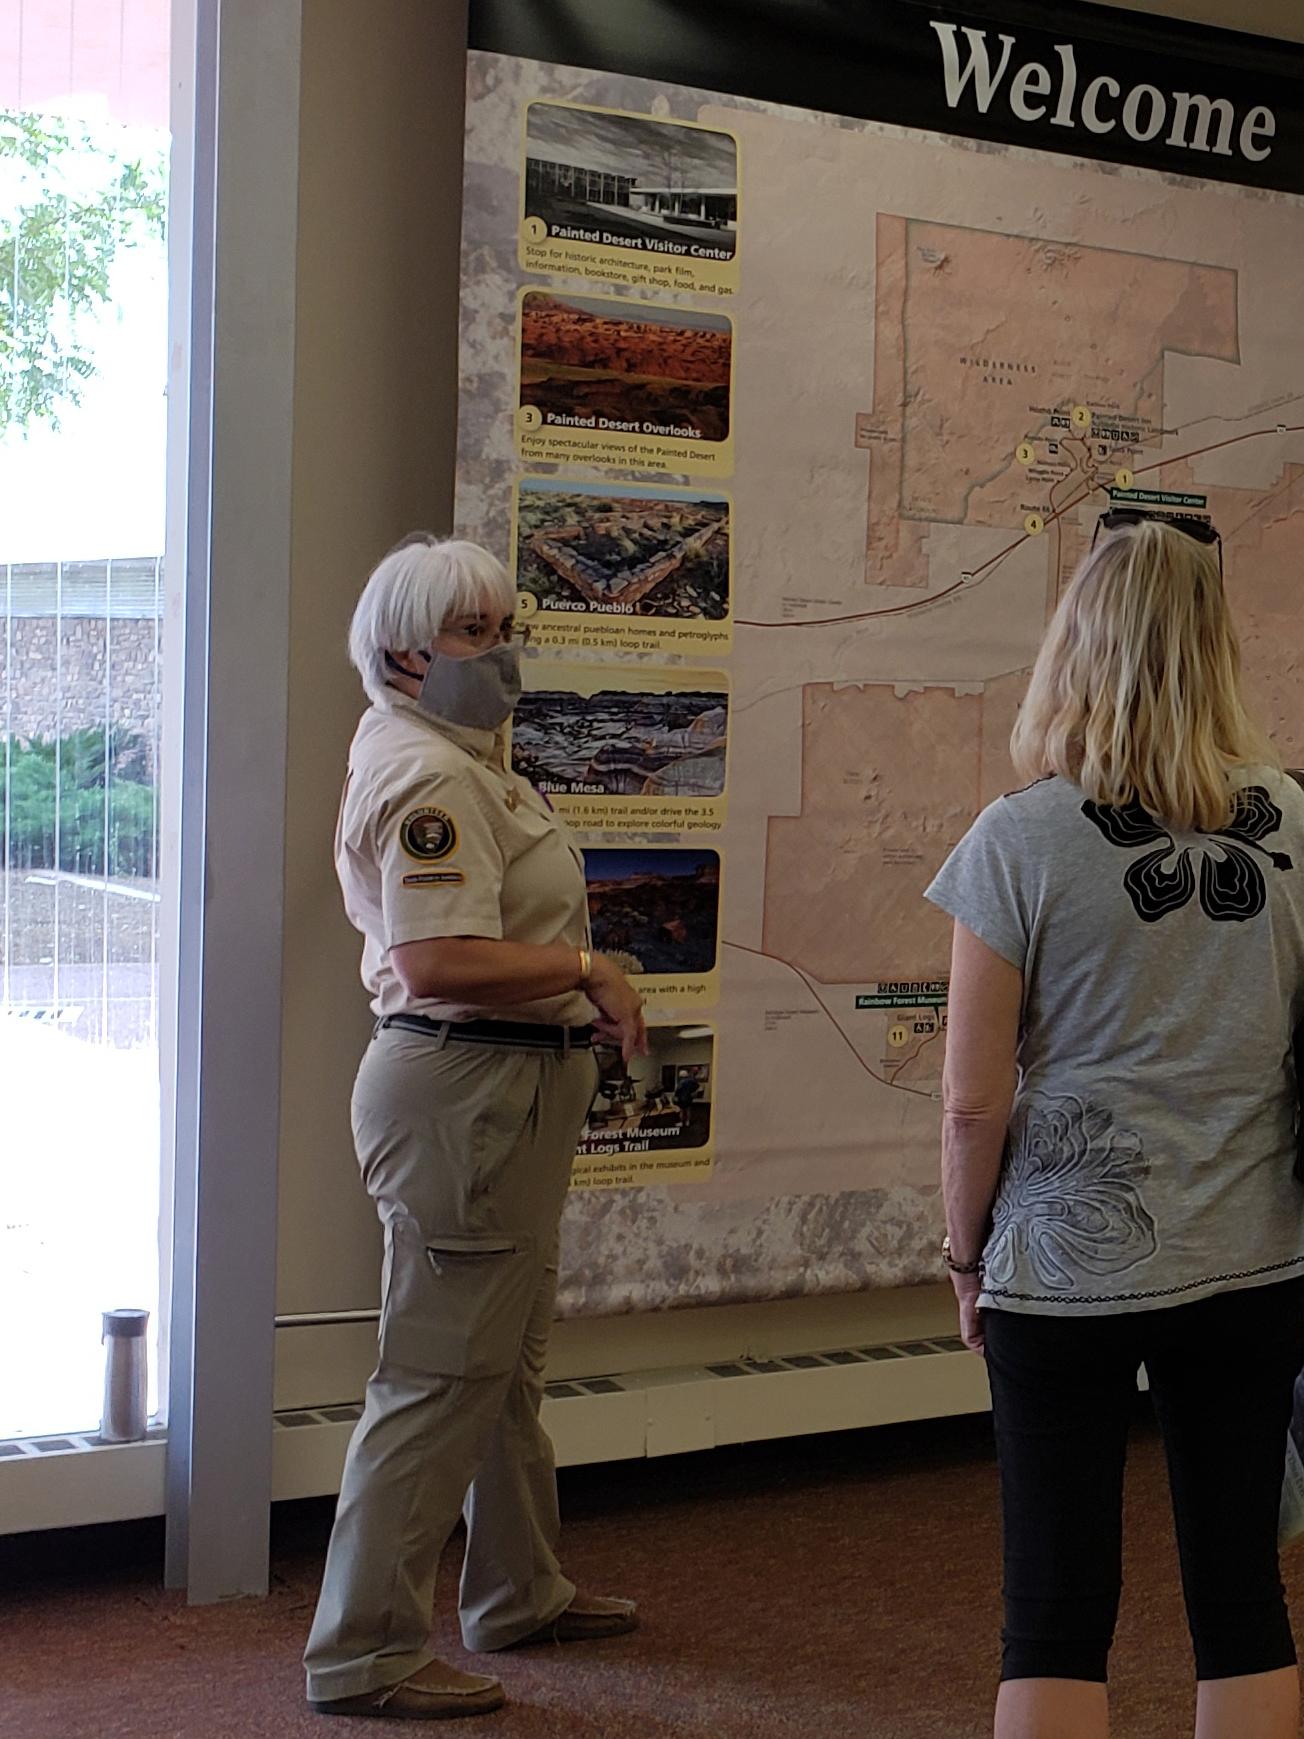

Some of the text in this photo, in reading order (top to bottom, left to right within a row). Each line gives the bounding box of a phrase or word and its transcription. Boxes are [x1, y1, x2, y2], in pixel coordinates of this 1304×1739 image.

[929, 20, 1276, 162] Welcome
[531, 224, 536, 234] 1
[551, 225, 733, 260] Painted Desert Visitor Center
[526, 247, 695, 278] Stop for historic architecture, park film,
[526, 261, 583, 275] information,
[585, 267, 630, 281] bookstore,
[632, 273, 647, 284] gift
[649, 276, 672, 288] shop,
[674, 280, 697, 291] food,
[698, 283, 716, 293] and
[959, 356, 1037, 374] WILDERNESS
[982, 375, 1014, 386] AREA
[525, 413, 533, 422] 3
[1079, 412, 1084, 421] 2
[547, 413, 701, 439] Painted Desert Overlooks
[521, 435, 716, 462] Enjoy spectacular views of the Painted Desert
[1022, 449, 1028, 458] 3
[521, 449, 543, 458] from
[546, 452, 570, 462] many
[572, 453, 616, 465] overlooks
[618, 457, 627, 465] in
[629, 458, 645, 467] this
[1122, 475, 1127, 483] 1
[1113, 490, 1205, 505] Painted Desert Visitor Center
[1030, 520, 1036, 529] 4
[521, 599, 528, 609] 5
[542, 599, 634, 614] Puerco Pueblo
[542, 623, 581, 633] ancestral
[584, 626, 625, 637] puebloan
[628, 628, 657, 637] homes
[659, 629, 676, 638] and
[677, 630, 729, 641] petroglyphs
[552, 636, 566, 645] 0.3
[568, 637, 580, 646] mi
[582, 636, 599, 647] (0.5
[601, 637, 617, 648] km)
[620, 639, 640, 649] loop
[538, 781, 605, 793] Blue Mesa
[591, 806, 609, 816] km)
[611, 807, 628, 815] trail
[630, 806, 658, 816] and/or
[660, 807, 682, 816] drive
[685, 807, 699, 816] the
[701, 808, 714, 816] 3.5
[583, 819, 603, 827] road
[605, 819, 615, 827] to
[617, 819, 649, 829] explore
[651, 819, 685, 829] colorful
[687, 820, 722, 830] geology
[658, 985, 678, 993] with
[688, 984, 706, 994] high
[859, 997, 892, 1006] Rainbow
[894, 996, 916, 1005] Forest
[897, 1014, 917, 1022] Giant
[892, 1032, 902, 1041] 11
[583, 1126, 680, 1140] Forest Museum
[591, 1144, 619, 1155] Logs
[623, 1140, 649, 1152] Trail
[593, 1164, 626, 1173] exhibits
[693, 1158, 710, 1166] and
[573, 1178, 591, 1187] km)
[593, 1178, 612, 1186] loop
